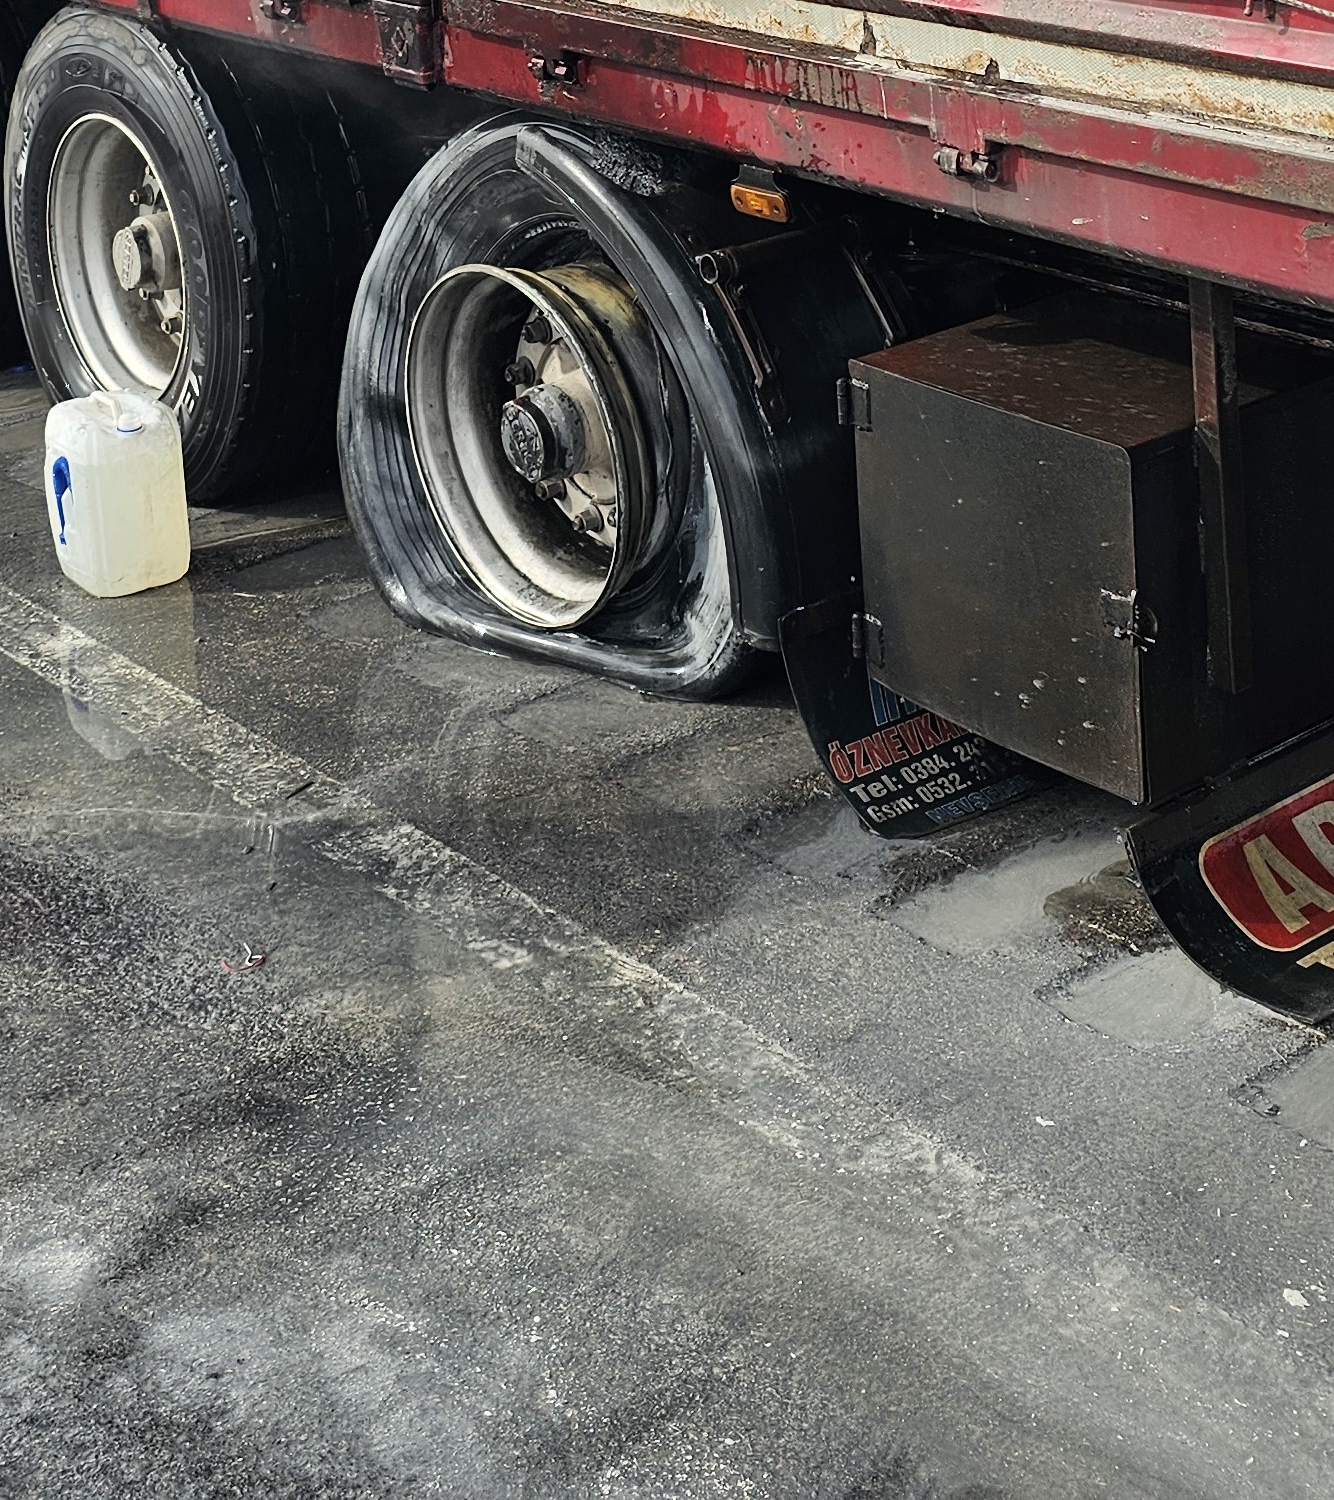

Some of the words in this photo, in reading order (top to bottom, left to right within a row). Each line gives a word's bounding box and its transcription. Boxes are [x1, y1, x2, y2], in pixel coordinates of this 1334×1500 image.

[827, 712, 970, 784] ÖZNEVKA
[849, 774, 904, 803] Tel:
[899, 753, 956, 784] 0384.
[866, 795, 920, 824] Gsm:
[915, 772, 973, 804] 0532.
